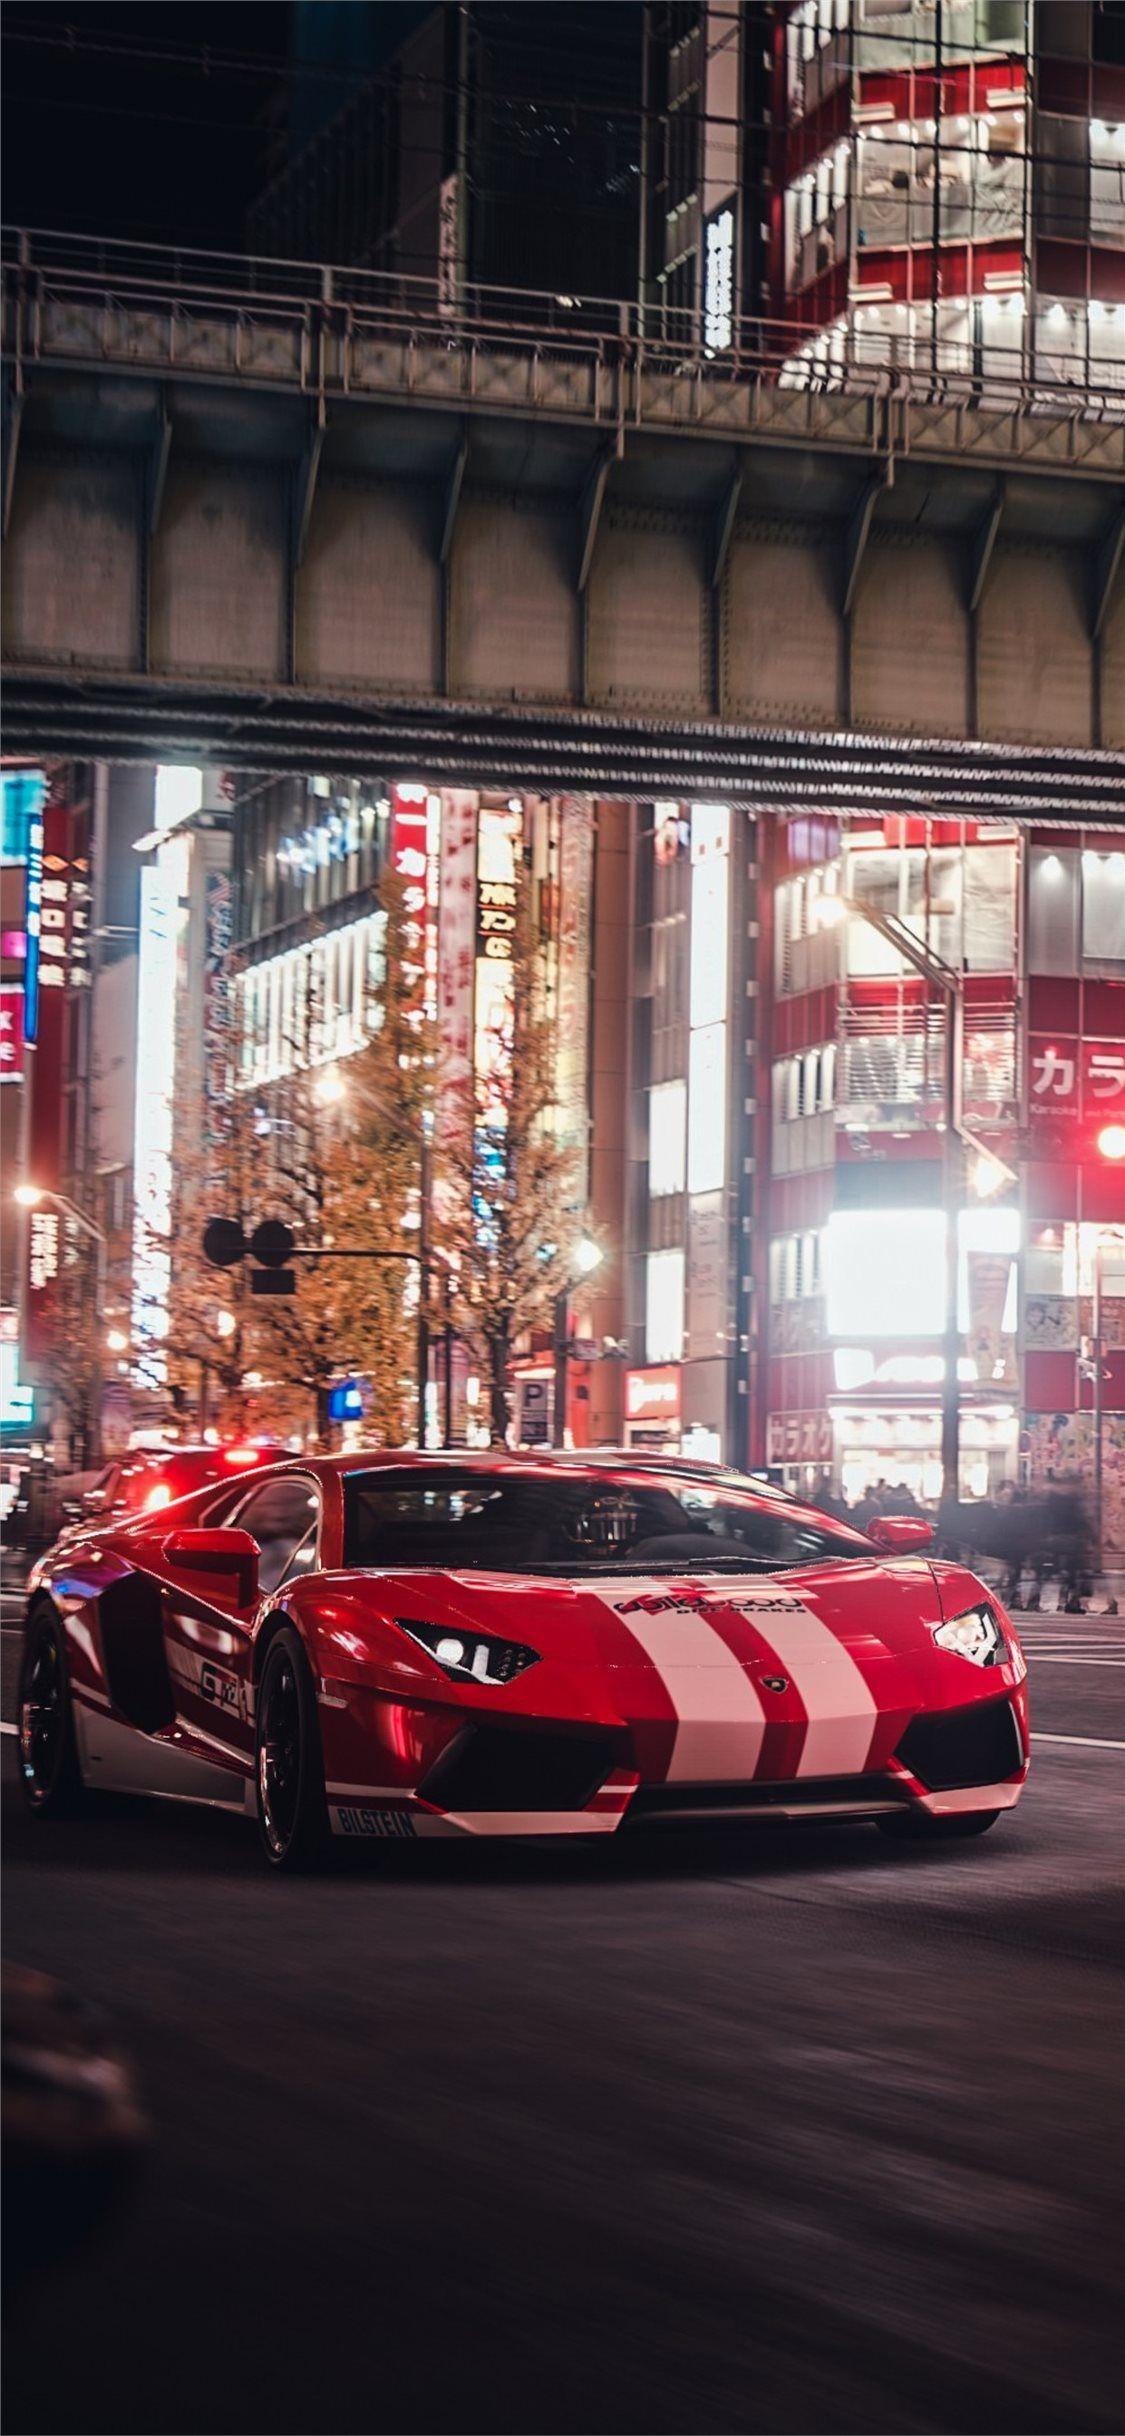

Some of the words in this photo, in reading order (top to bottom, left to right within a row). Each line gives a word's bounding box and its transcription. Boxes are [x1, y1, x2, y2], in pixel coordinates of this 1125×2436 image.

[1032, 1048, 1125, 1098] カラ
[524, 1384, 542, 1407] P
[338, 1808, 418, 1836] BILSTEIN
